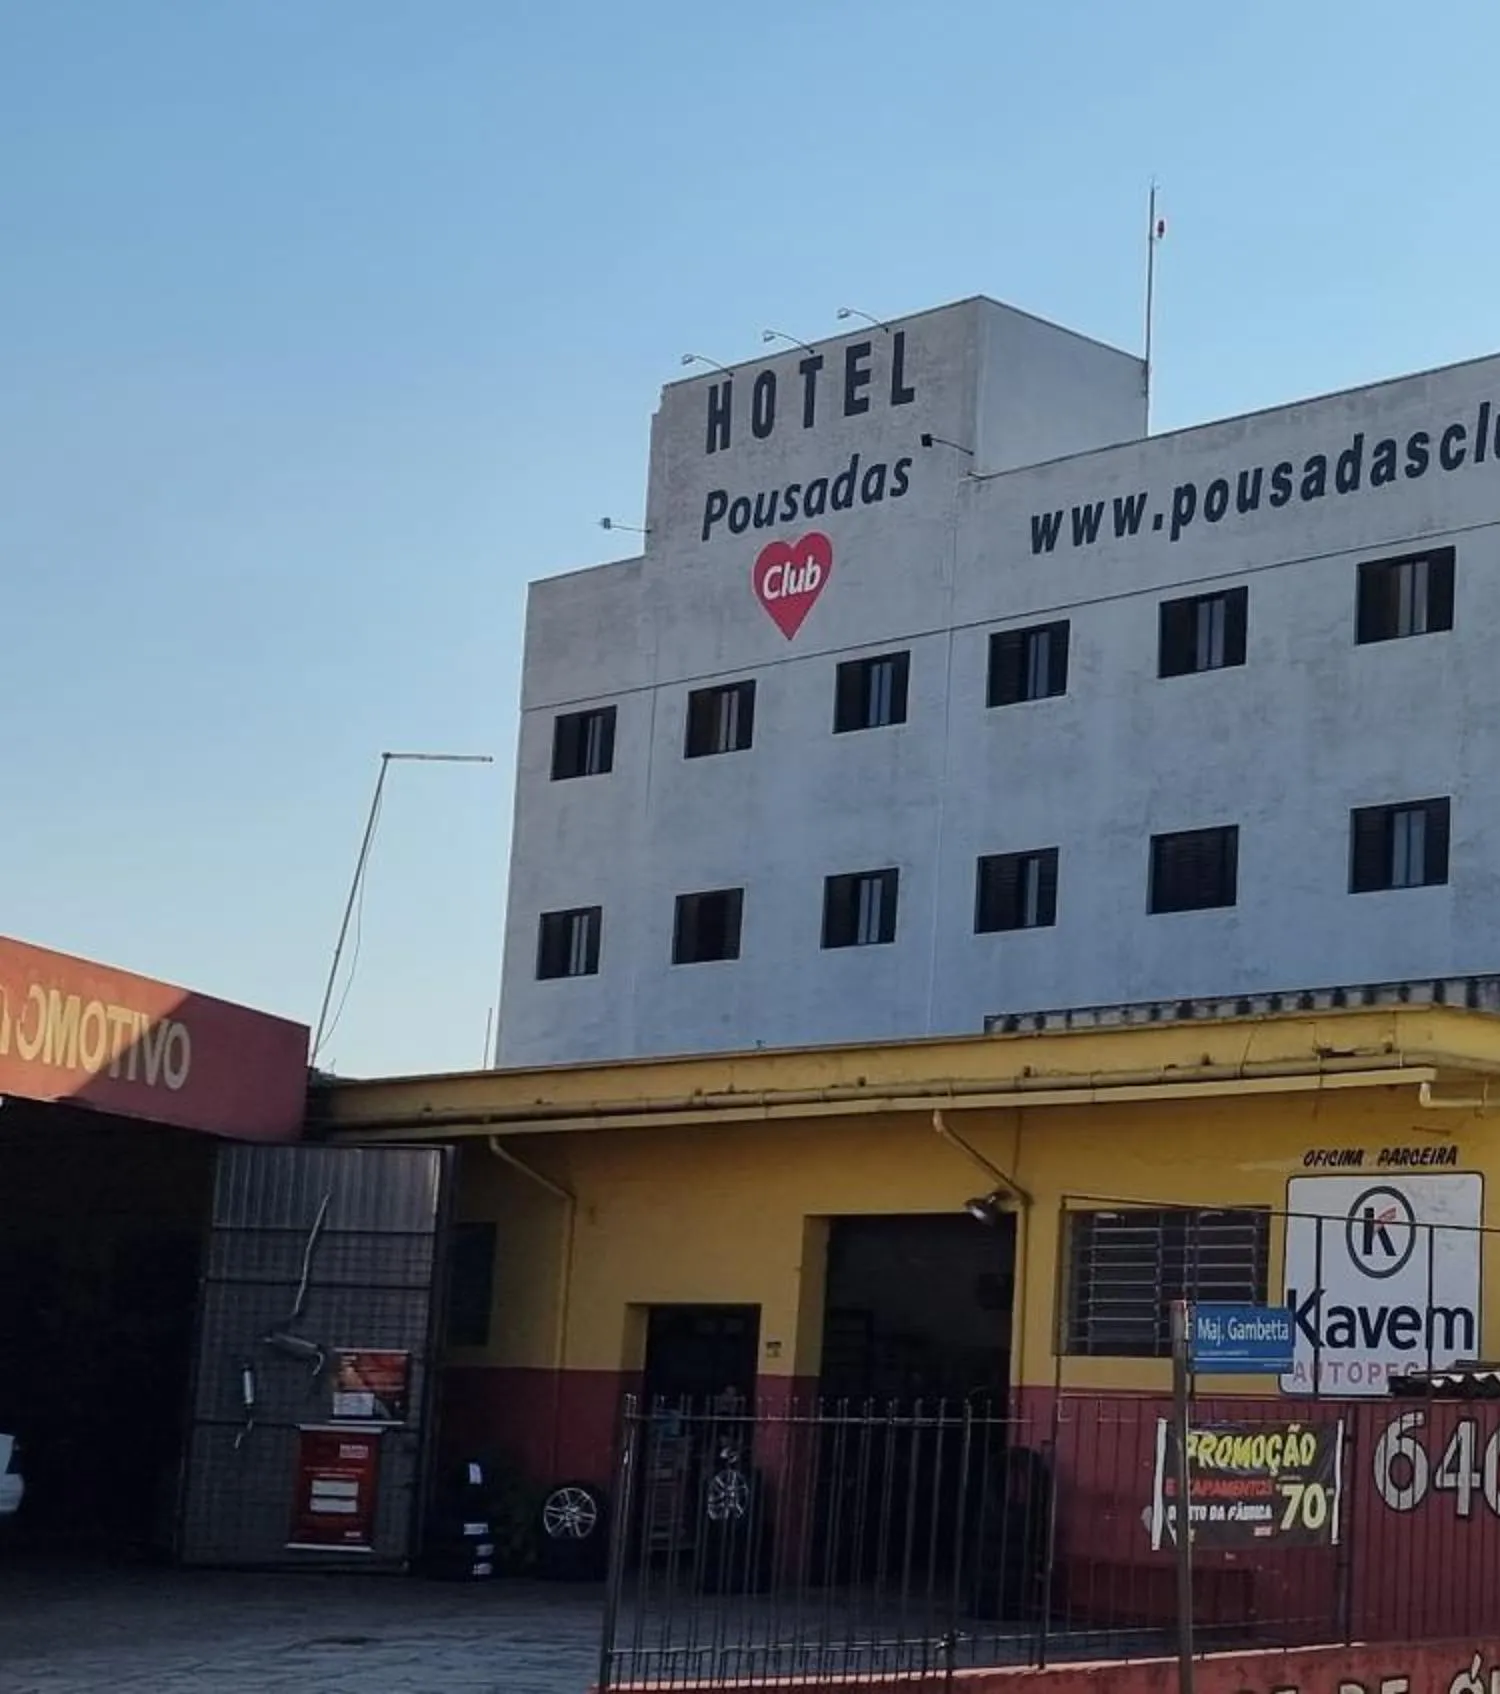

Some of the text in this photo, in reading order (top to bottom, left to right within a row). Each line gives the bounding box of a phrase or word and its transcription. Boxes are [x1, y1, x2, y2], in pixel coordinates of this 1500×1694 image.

[705, 330, 916, 455] HOTEL
[701, 453, 913, 541] Pousadas
[762, 555, 822, 602] Club
[1303, 1144, 1459, 1168] OFICINA PARCEIRA
[1197, 1316, 1289, 1347] Maj. Gambetta
[1287, 1288, 1476, 1351] Kavem
[1187, 1423, 1318, 1477] PROMOÇÃO
[1279, 1482, 1327, 1530] 70
